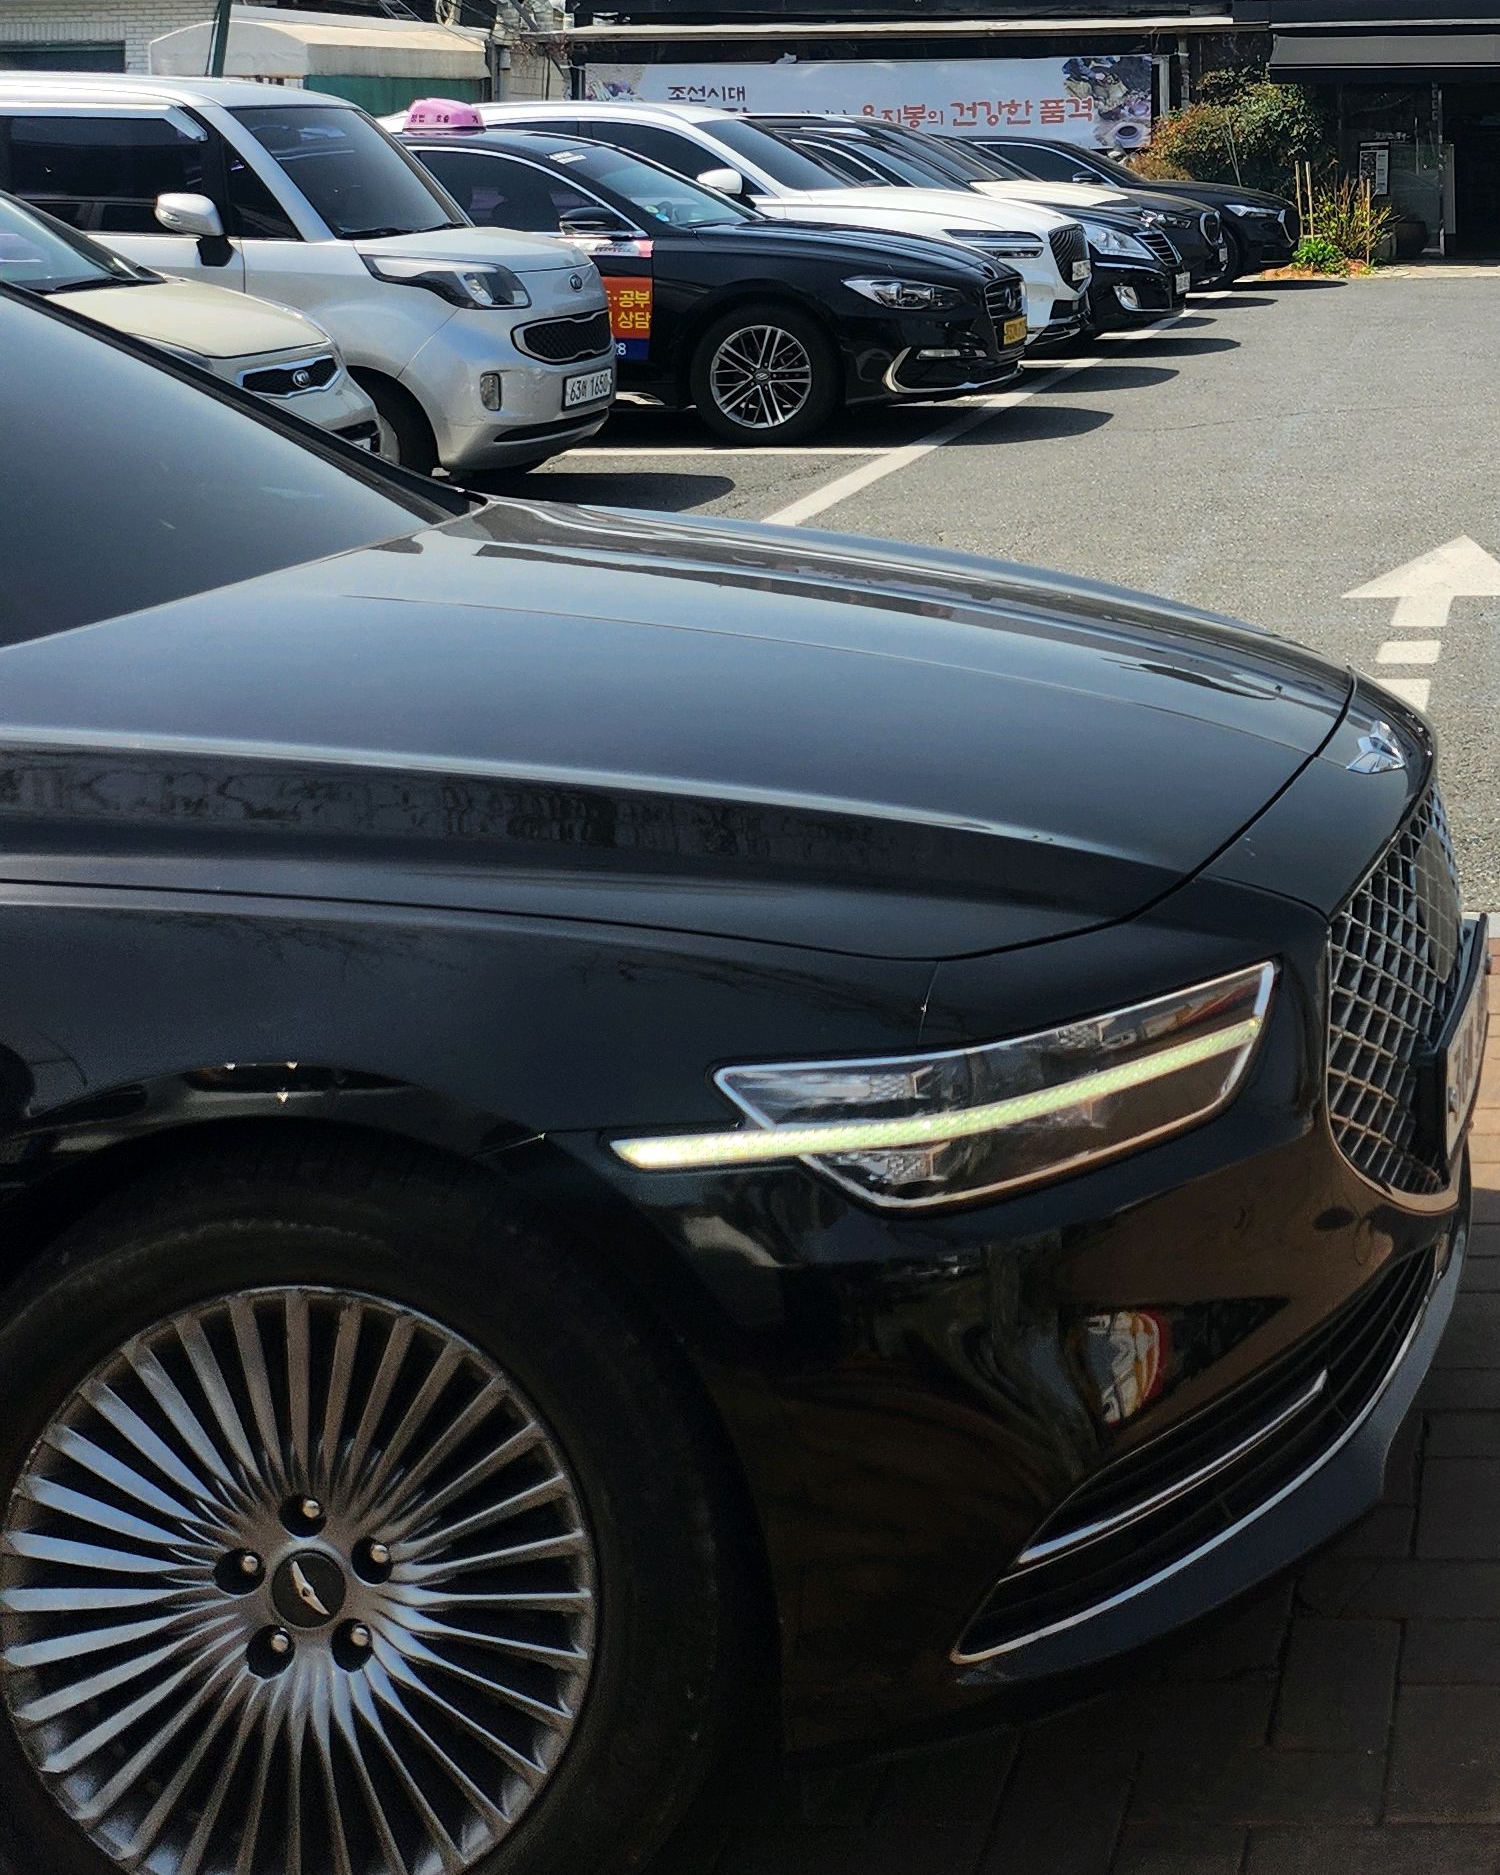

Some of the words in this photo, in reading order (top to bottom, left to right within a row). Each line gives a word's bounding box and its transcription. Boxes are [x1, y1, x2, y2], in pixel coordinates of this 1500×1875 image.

[667, 85, 746, 103] 조선시대
[950, 98, 1034, 127] 건강한
[1039, 96, 1094, 125] 품격
[618, 310, 652, 330] 상담
